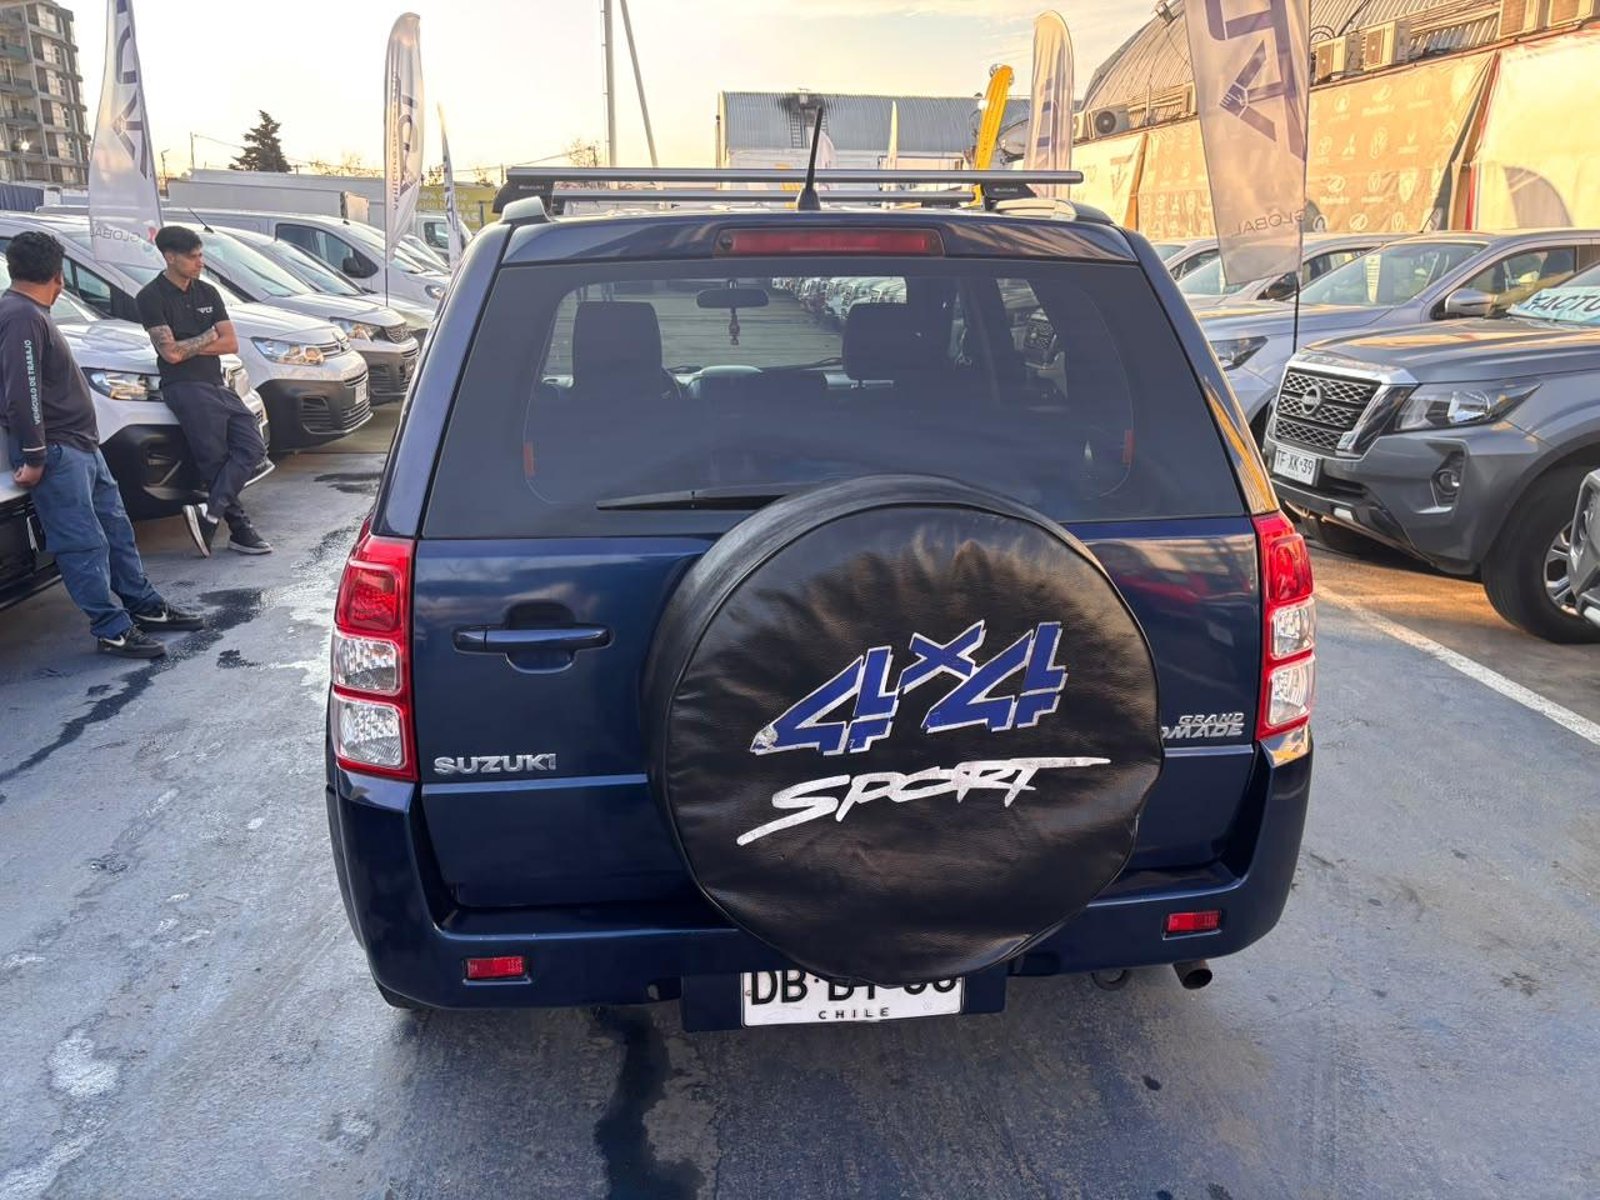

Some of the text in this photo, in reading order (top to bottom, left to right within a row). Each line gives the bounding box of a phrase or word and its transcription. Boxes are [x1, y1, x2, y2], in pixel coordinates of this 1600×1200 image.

[24, 339, 35, 375] TRABAJO
[1178, 711, 1245, 727] GRAND
[433, 753, 557, 775] SUZUKI
[736, 756, 1112, 847] SPORT
[818, 1006, 890, 1020] CHILE
